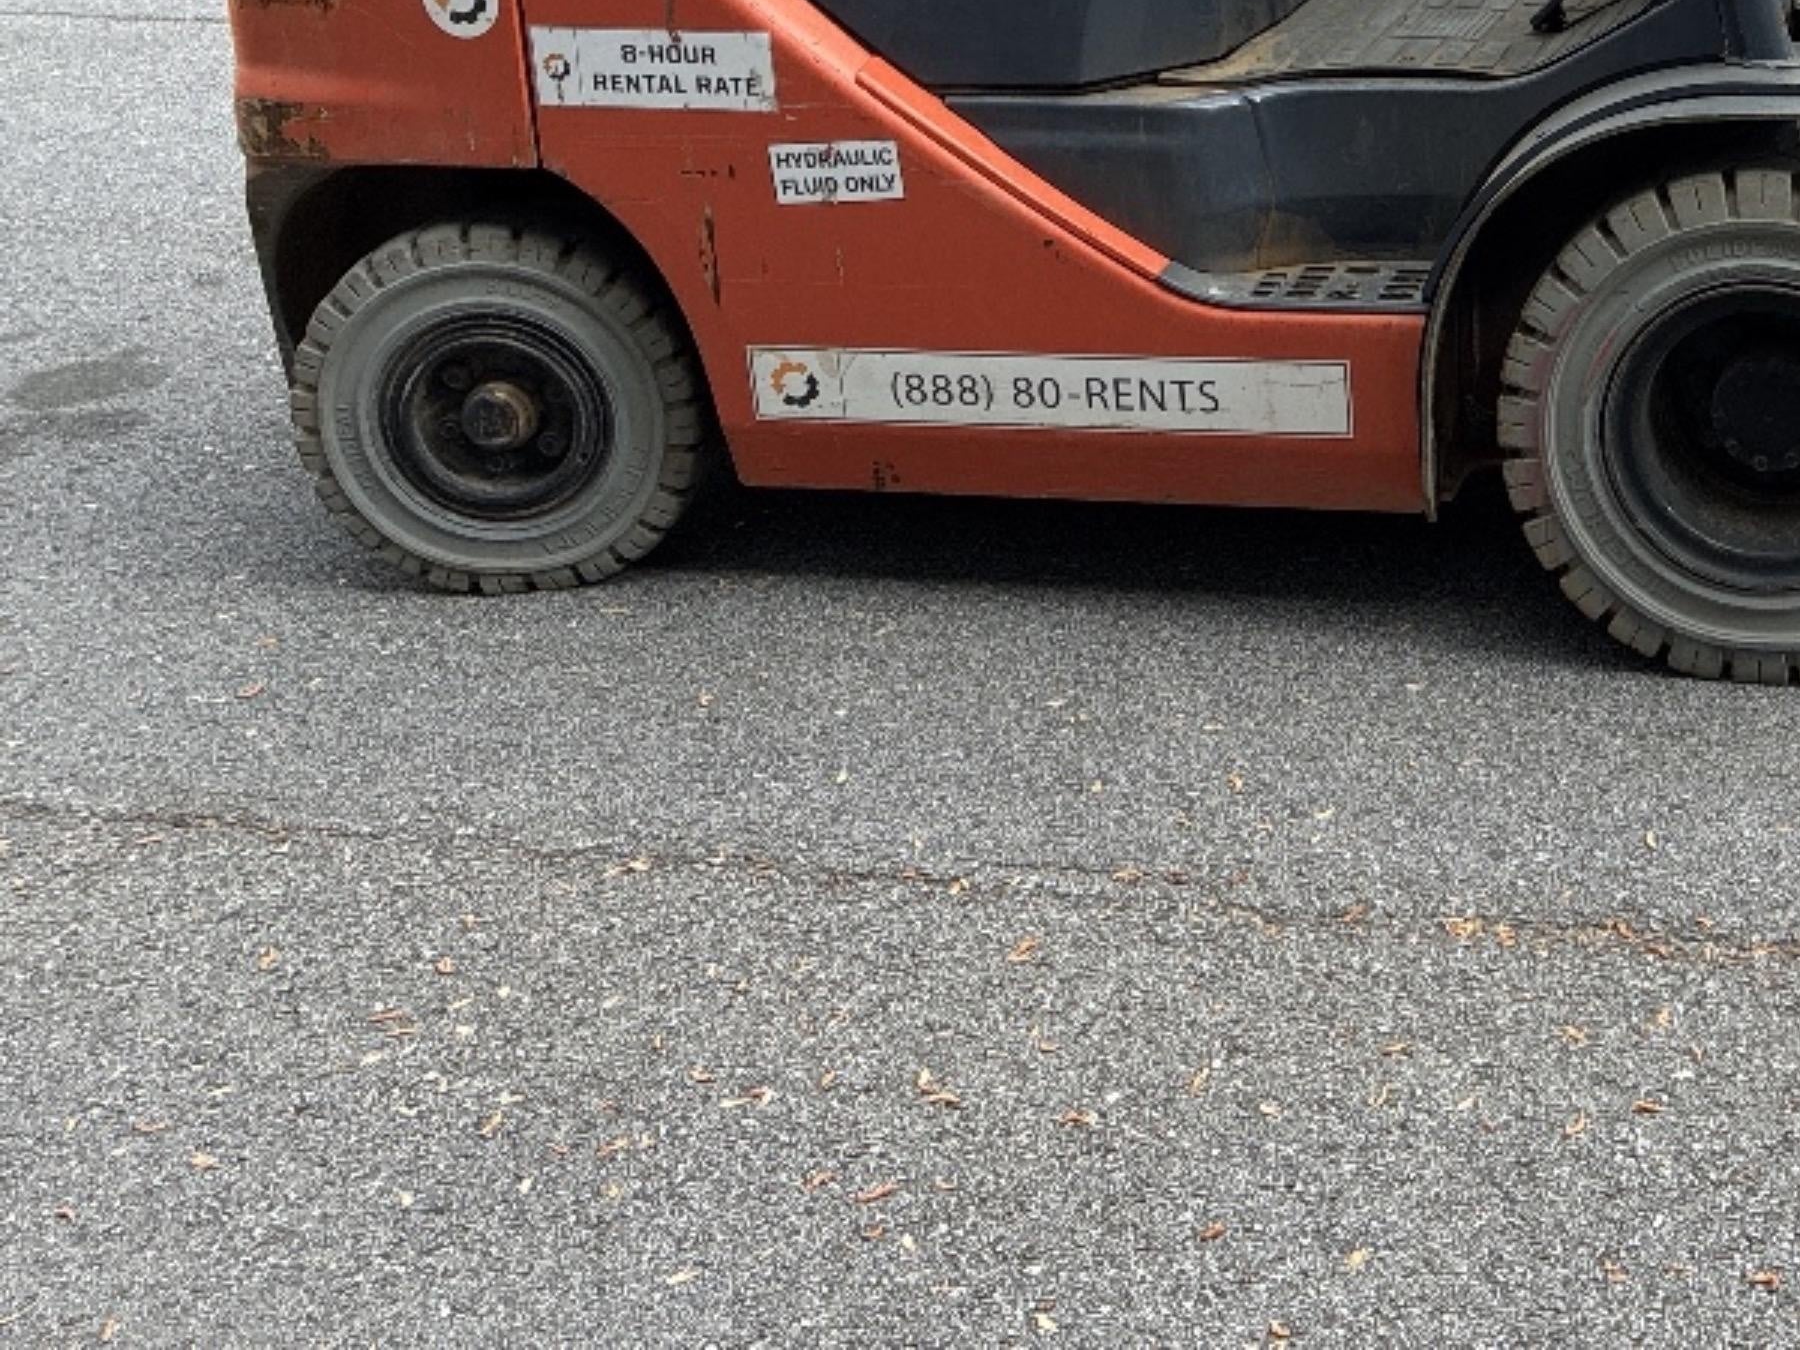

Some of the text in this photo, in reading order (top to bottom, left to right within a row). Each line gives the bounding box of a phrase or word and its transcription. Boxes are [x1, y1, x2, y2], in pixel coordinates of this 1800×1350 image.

[620, 44, 717, 66] 8-HOUR
[592, 73, 762, 98] RENTAL RATE
[775, 146, 893, 170] HYDRAULIC
[779, 173, 896, 197] FLUID ONLY
[890, 370, 1220, 413] (888) 80-RENTS
